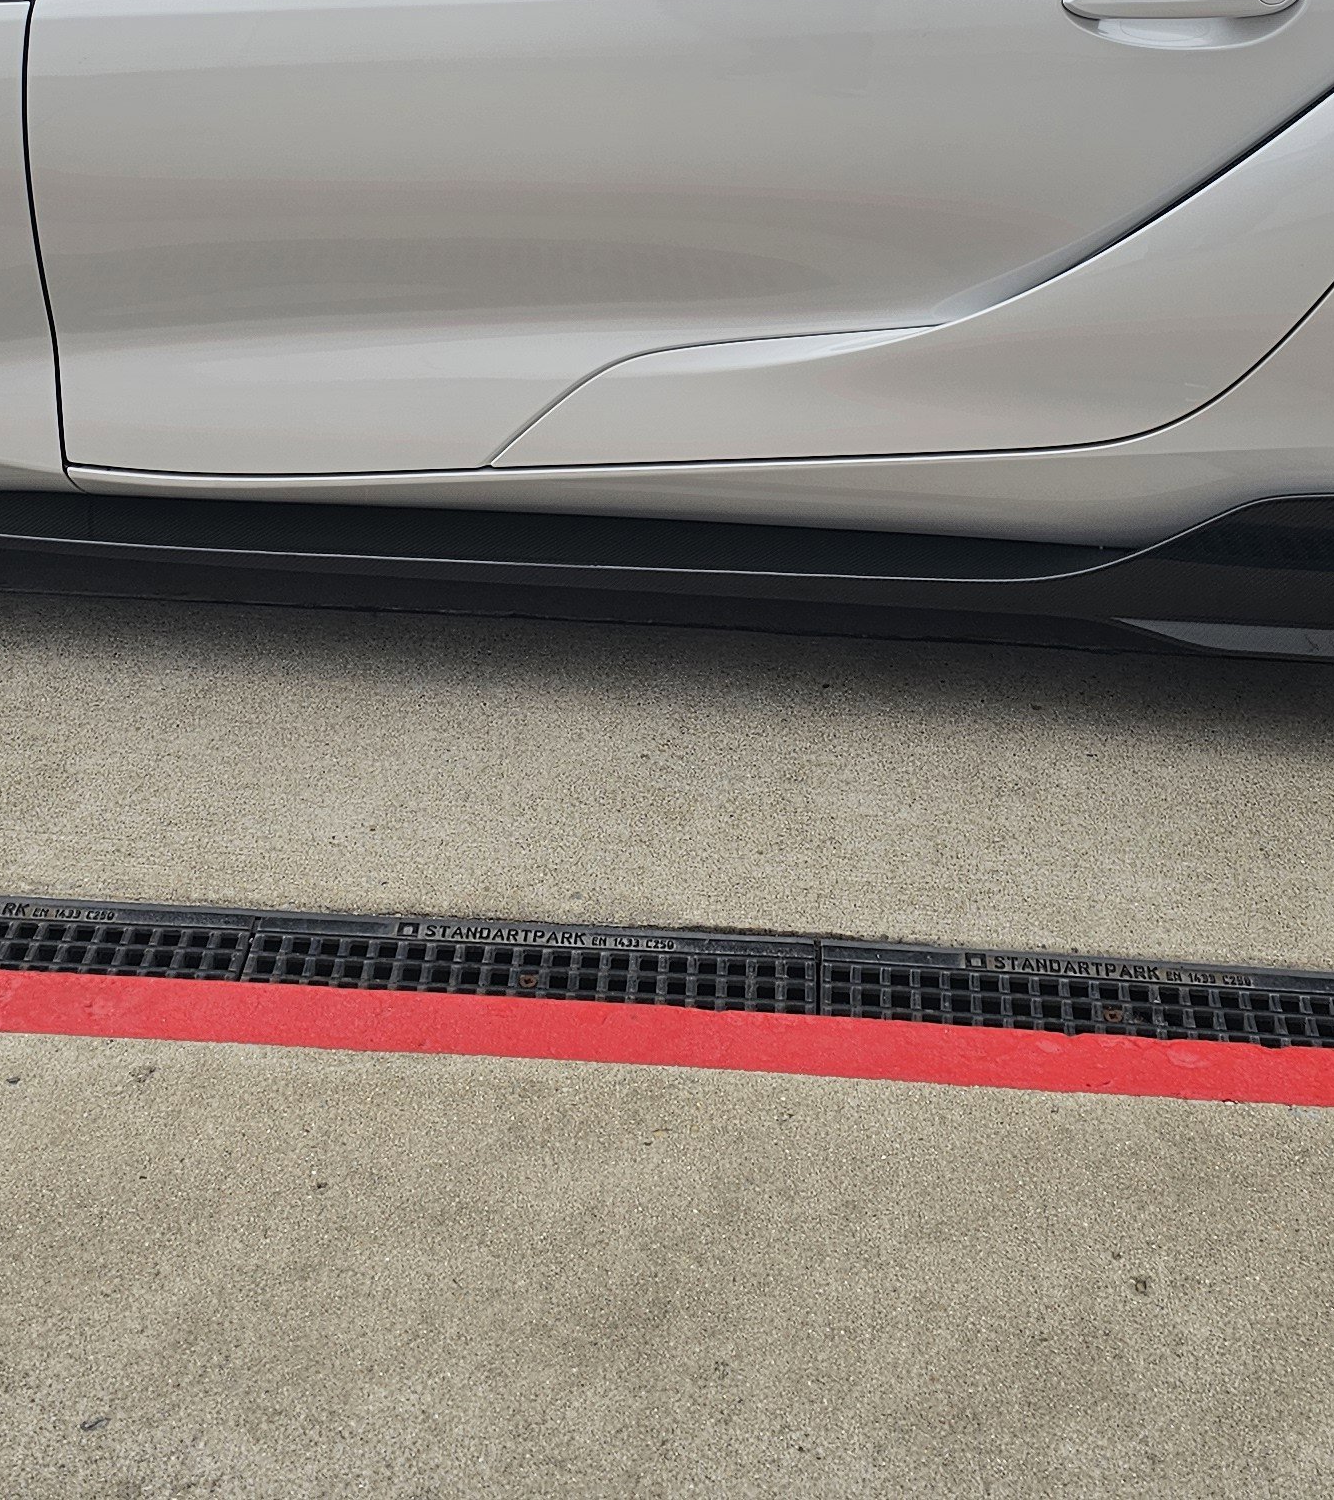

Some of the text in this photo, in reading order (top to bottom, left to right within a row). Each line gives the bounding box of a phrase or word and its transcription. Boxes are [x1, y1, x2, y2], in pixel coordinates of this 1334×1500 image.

[85, 910, 116, 921] C250
[424, 924, 675, 950] STANDARTPARK EN 1433 C250
[994, 955, 1161, 981] STANDARTPARK
[1165, 971, 1182, 982] EN
